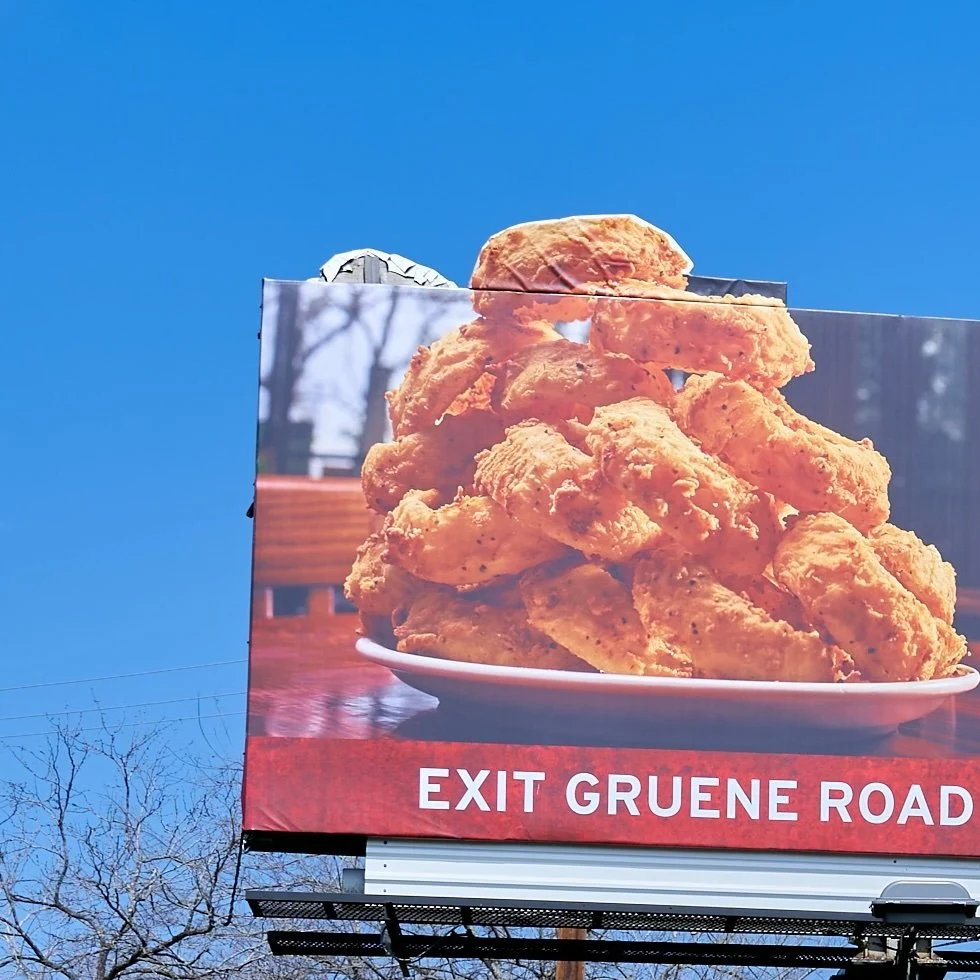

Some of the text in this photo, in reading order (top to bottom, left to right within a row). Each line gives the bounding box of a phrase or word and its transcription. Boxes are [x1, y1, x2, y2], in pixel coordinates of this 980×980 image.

[418, 767, 546, 813] EXIT
[565, 772, 799, 821] GRUENE
[820, 781, 975, 827] ROAD
